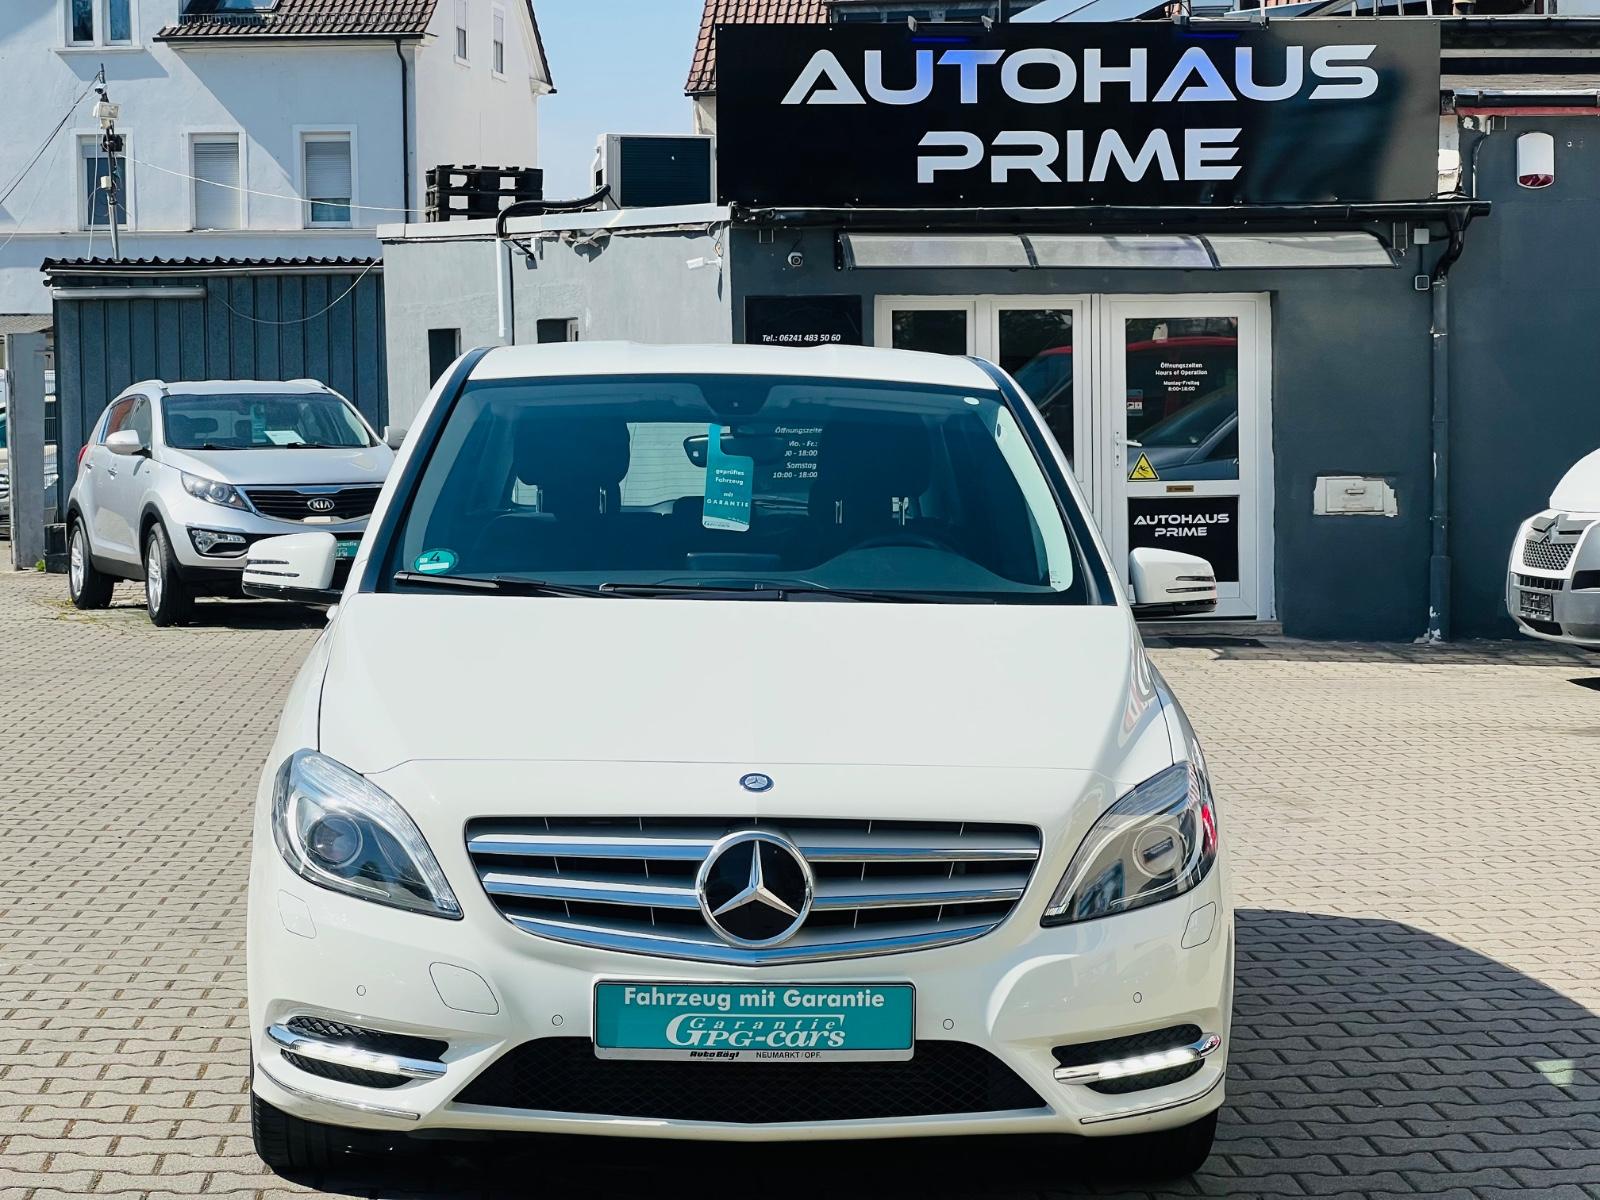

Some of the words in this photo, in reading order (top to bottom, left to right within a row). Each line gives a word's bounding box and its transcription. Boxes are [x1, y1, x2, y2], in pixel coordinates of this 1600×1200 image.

[780, 44, 1379, 105] AUTOHAUS
[917, 127, 1243, 184] PRIME
[762, 334, 778, 342] Tel.:
[779, 334, 802, 342] 06241
[804, 334, 818, 342] 483
[820, 334, 830, 342] 50
[831, 334, 841, 342] 60
[1160, 361, 1203, 369] Öffnungszeiten
[774, 426, 823, 435] Öffnungszeite
[798, 449, 818, 457] 18:00
[786, 461, 817, 470] Samstag
[715, 469, 745, 477] geprüftes
[772, 471, 793, 479] 10:00
[715, 476, 744, 486] Fahrzeug
[312, 500, 331, 509] KIA
[706, 498, 749, 508] GARANTIE
[1133, 513, 1230, 526] AUTOHAUS
[1154, 526, 1208, 538] PRIME
[429, 551, 441, 562] 4
[624, 986, 731, 1012] Fahrzeug
[739, 988, 776, 1007] mit
[783, 987, 886, 1009] Garantie
[689, 1017, 837, 1030] Garantie
[756, 1051, 800, 1059] NEUMARKT
